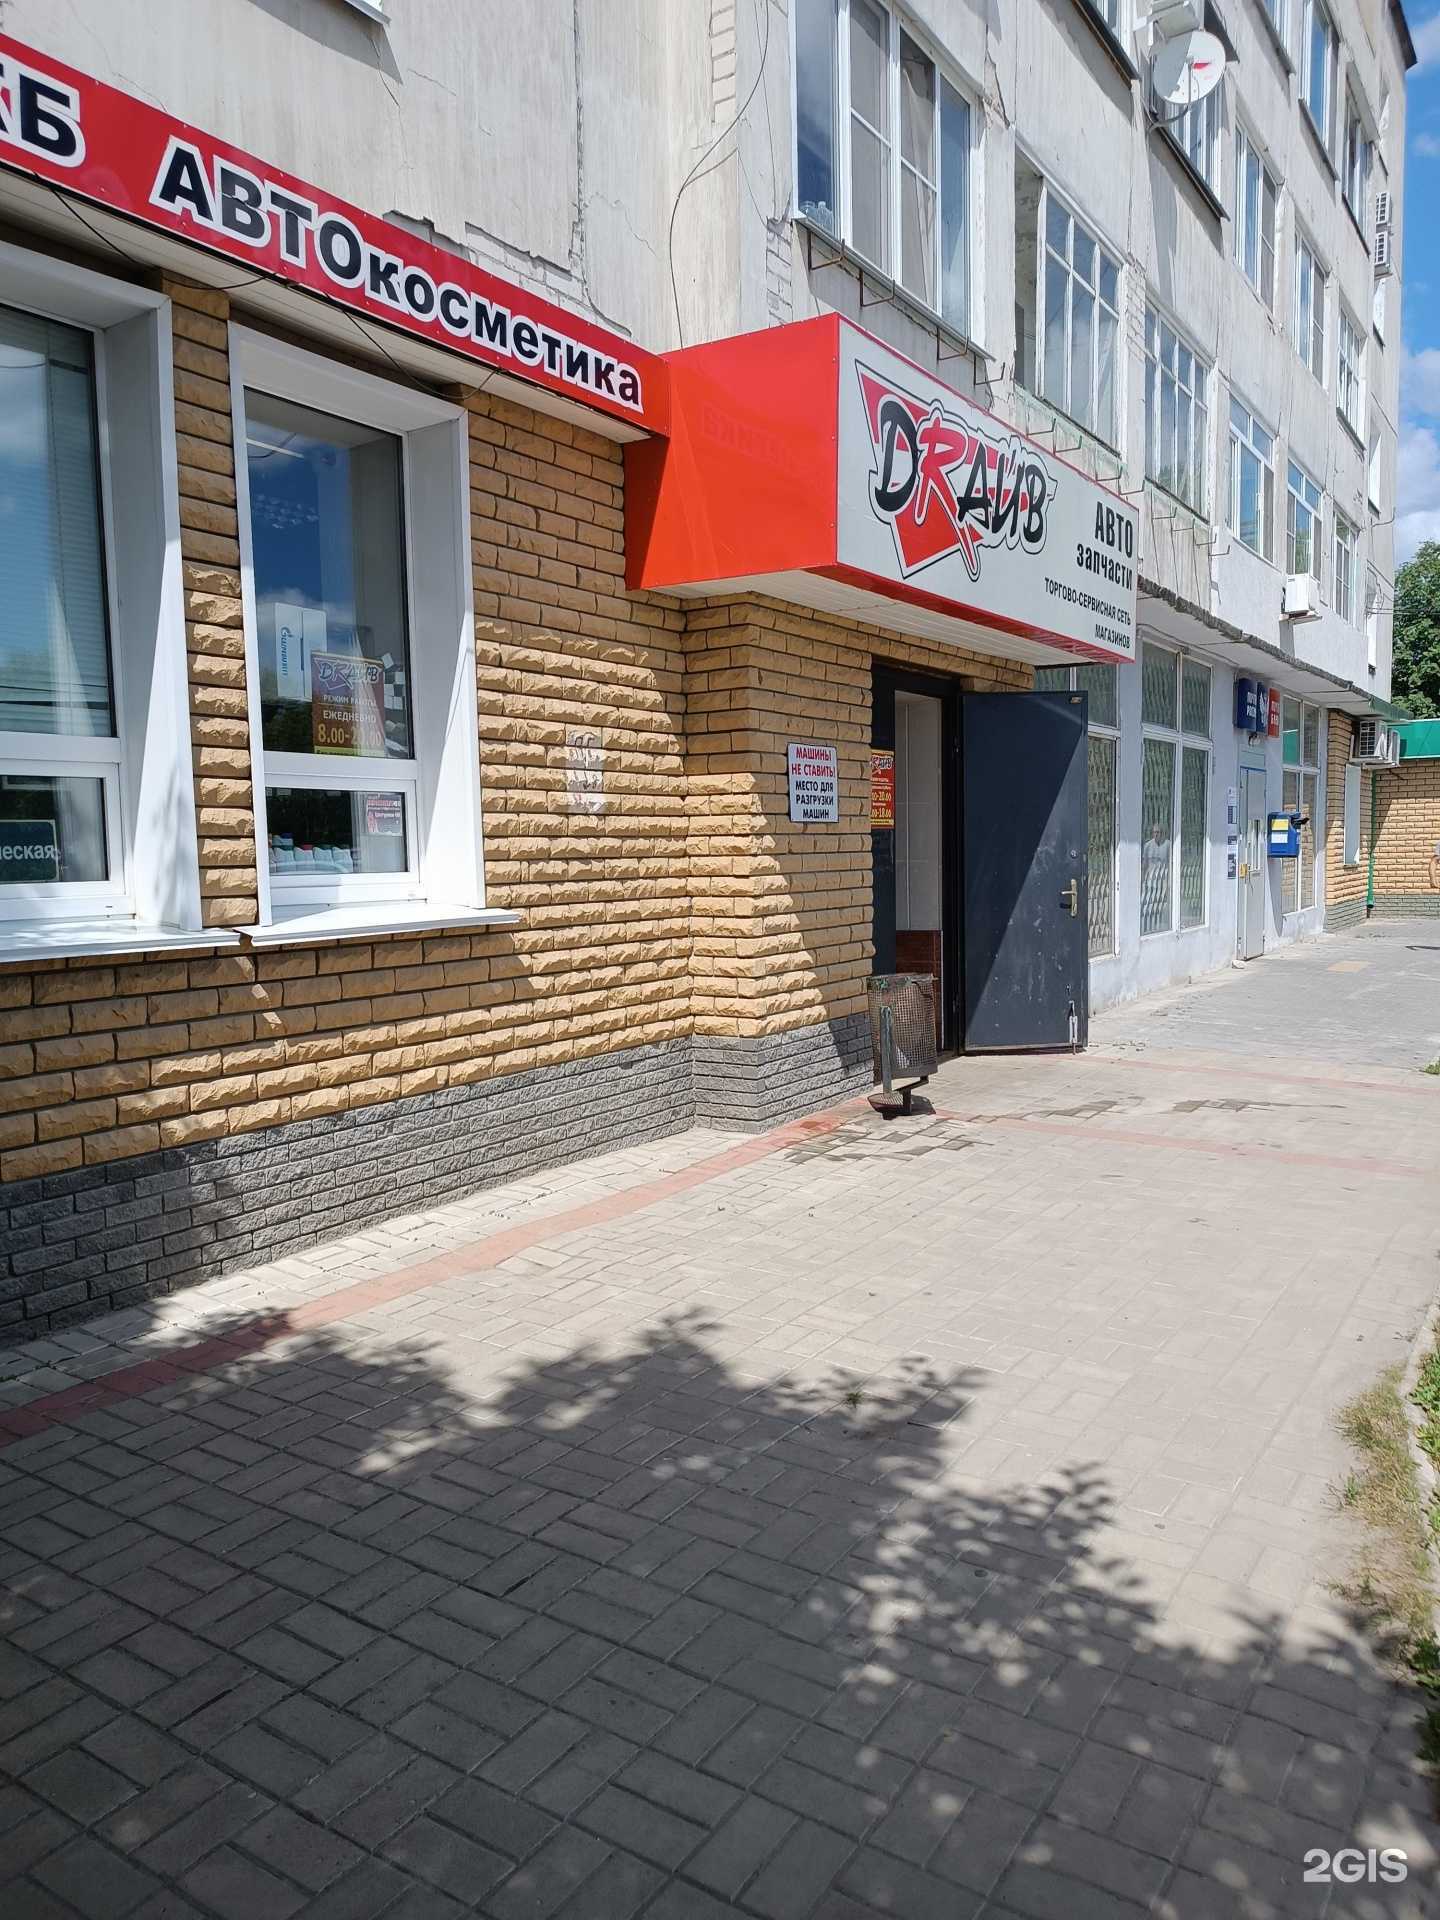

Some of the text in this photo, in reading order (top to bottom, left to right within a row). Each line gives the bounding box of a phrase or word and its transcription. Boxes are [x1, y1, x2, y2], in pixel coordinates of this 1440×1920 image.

[0, 58, 642, 406] Б АВТОкосметика
[1094, 500, 1134, 559] АВТО
[1076, 543, 1133, 591] запчасти
[1044, 576, 1132, 626] ТОРГОВО-СЕРВИСНАЯ СЕТЬ
[1094, 623, 1131, 649] МАГАЗИНОВ
[323, 709, 377, 724] ЕЖЕДНЕВНО
[795, 746, 832, 761] МАШИНЫ
[791, 763, 802, 775] НЕ
[795, 780, 834, 794] МЕСТО ДЛЯ
[795, 794, 834, 806] РАЗГРУЗКИ
[802, 808, 830, 819] МАШИН
